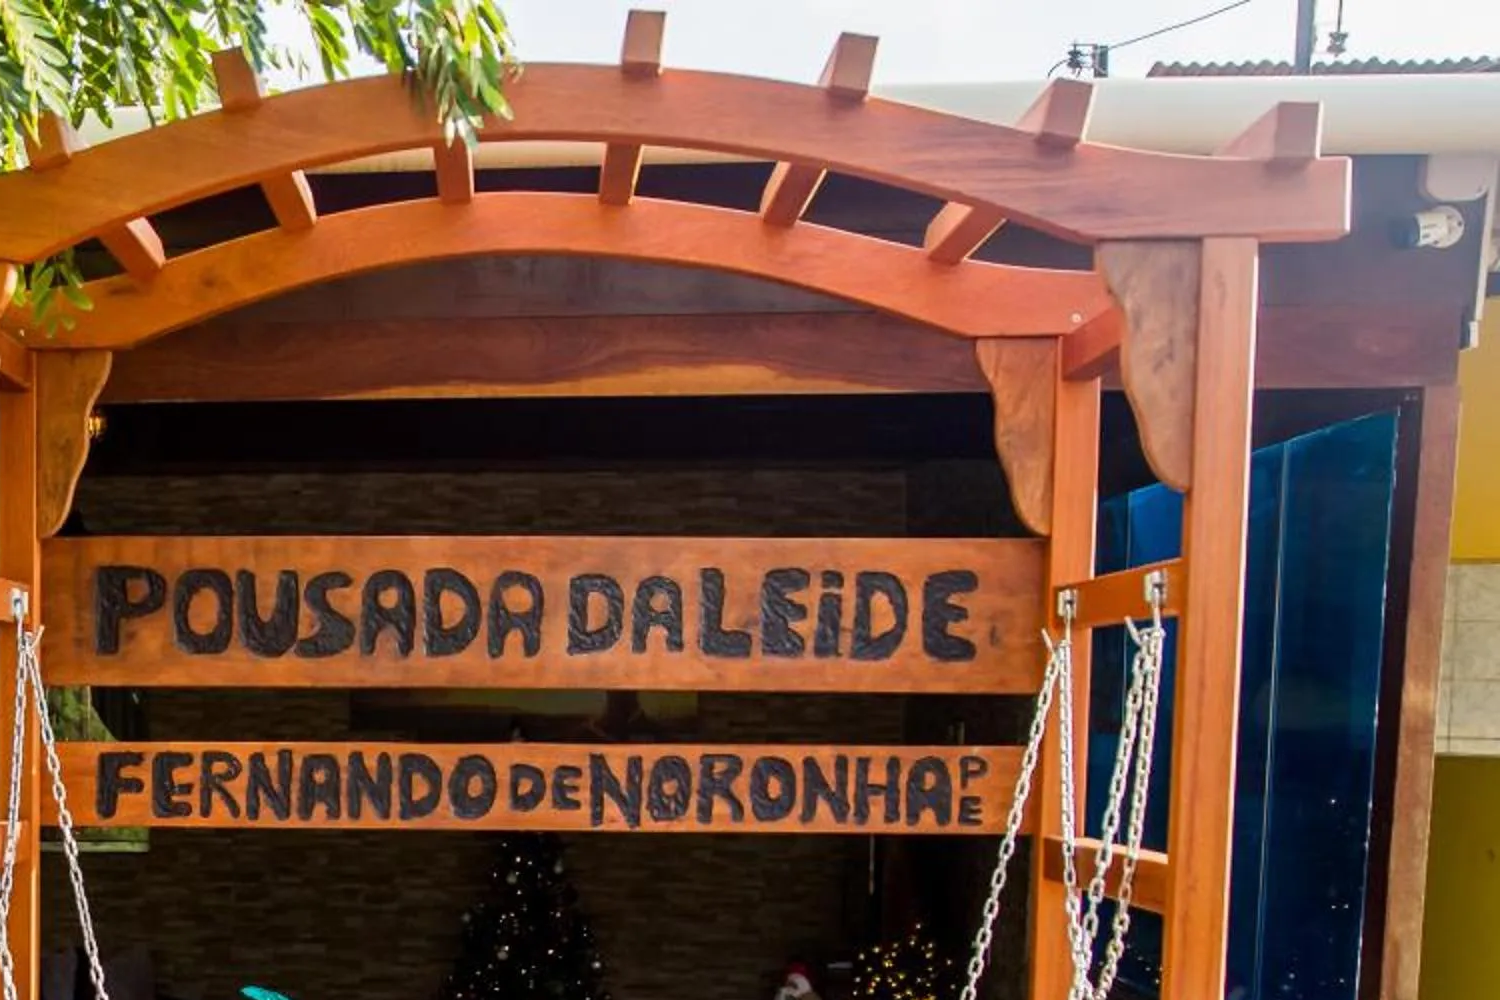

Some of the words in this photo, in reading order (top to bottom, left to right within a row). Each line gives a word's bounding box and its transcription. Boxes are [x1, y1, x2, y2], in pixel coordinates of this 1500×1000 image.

[94, 563, 546, 660] POUSADA
[94, 747, 499, 822] FERNANDO
[508, 762, 584, 812] DE
[588, 752, 953, 829] NORONHA
